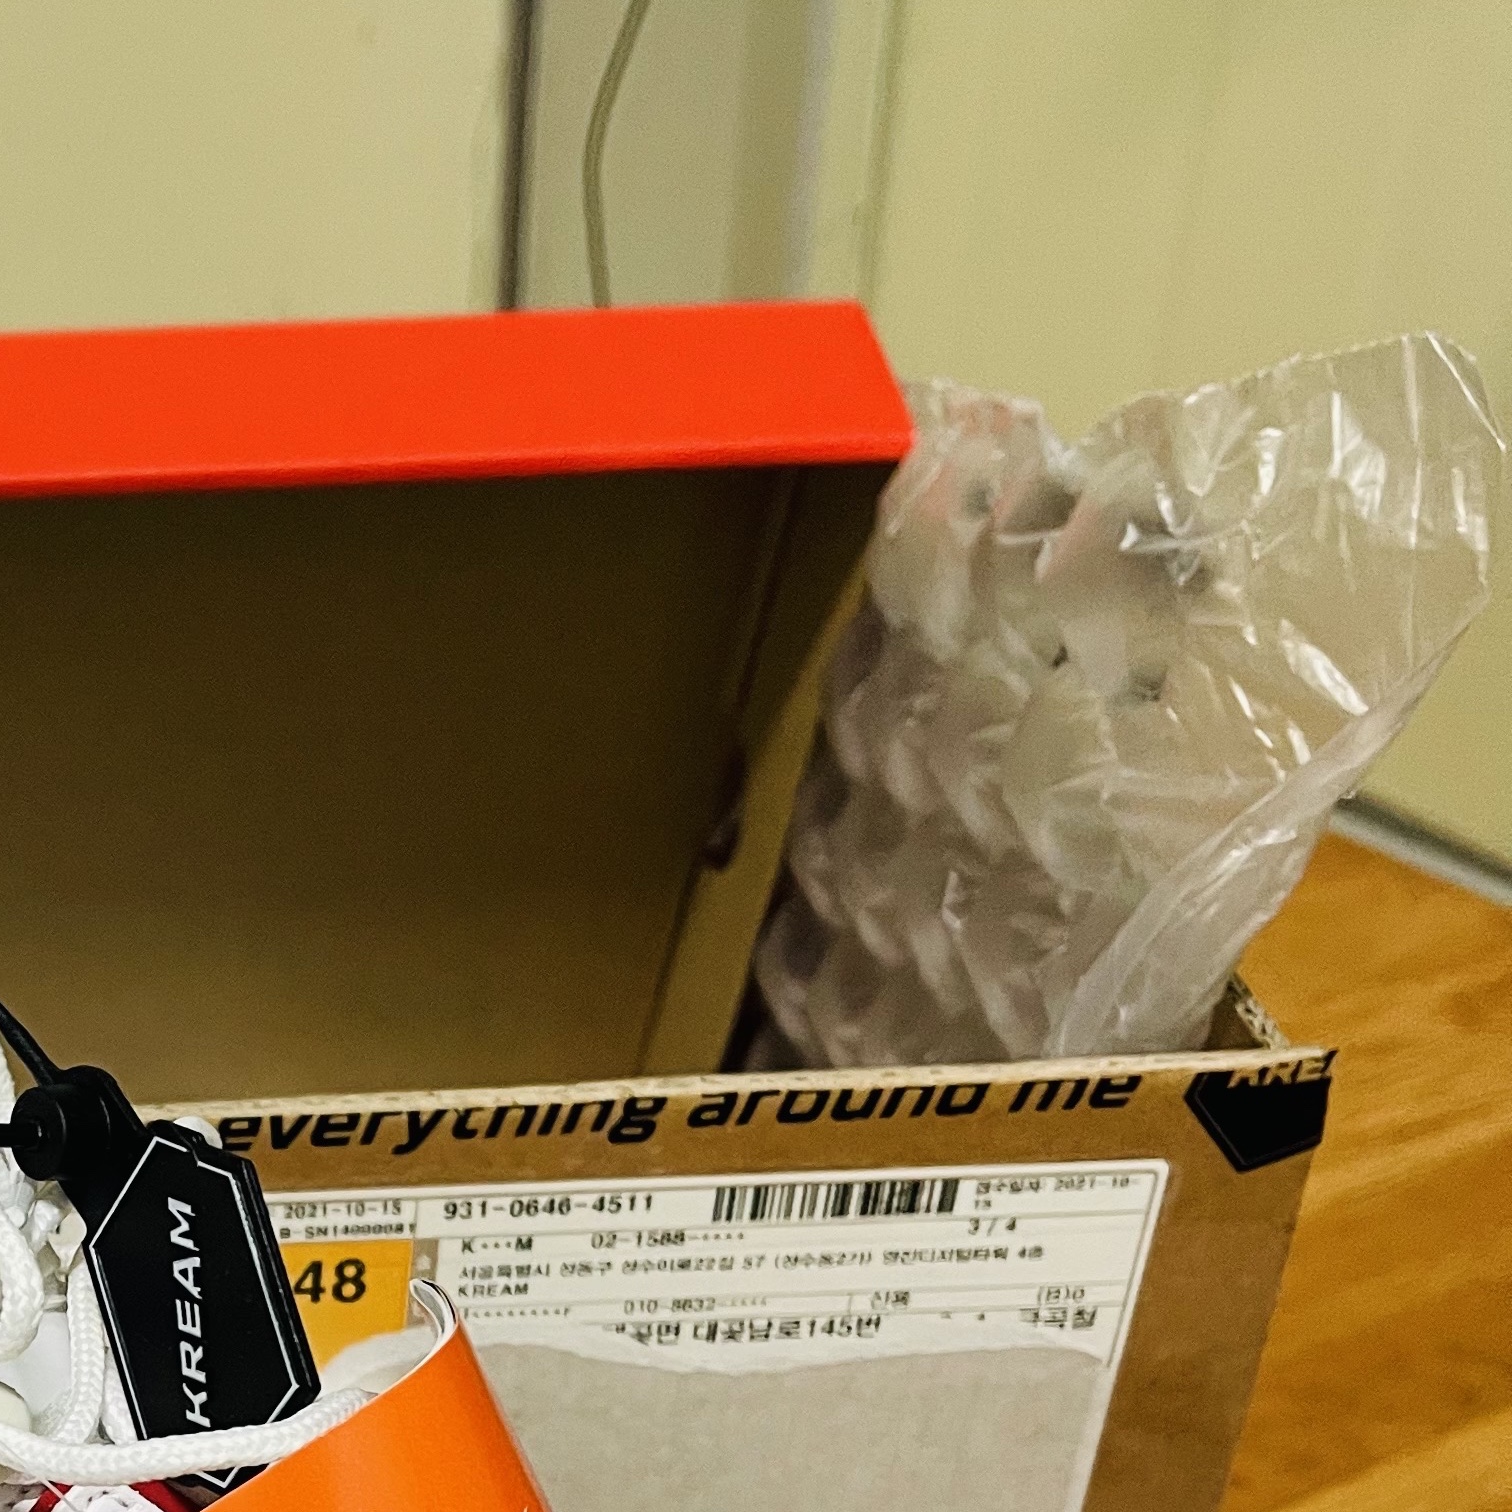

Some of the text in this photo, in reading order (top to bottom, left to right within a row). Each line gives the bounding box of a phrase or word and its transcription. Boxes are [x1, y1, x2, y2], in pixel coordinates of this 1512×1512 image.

[217, 1073, 1142, 1155] everything around me
[168, 1196, 211, 1429] KREAM
[294, 1258, 367, 1304] 48
